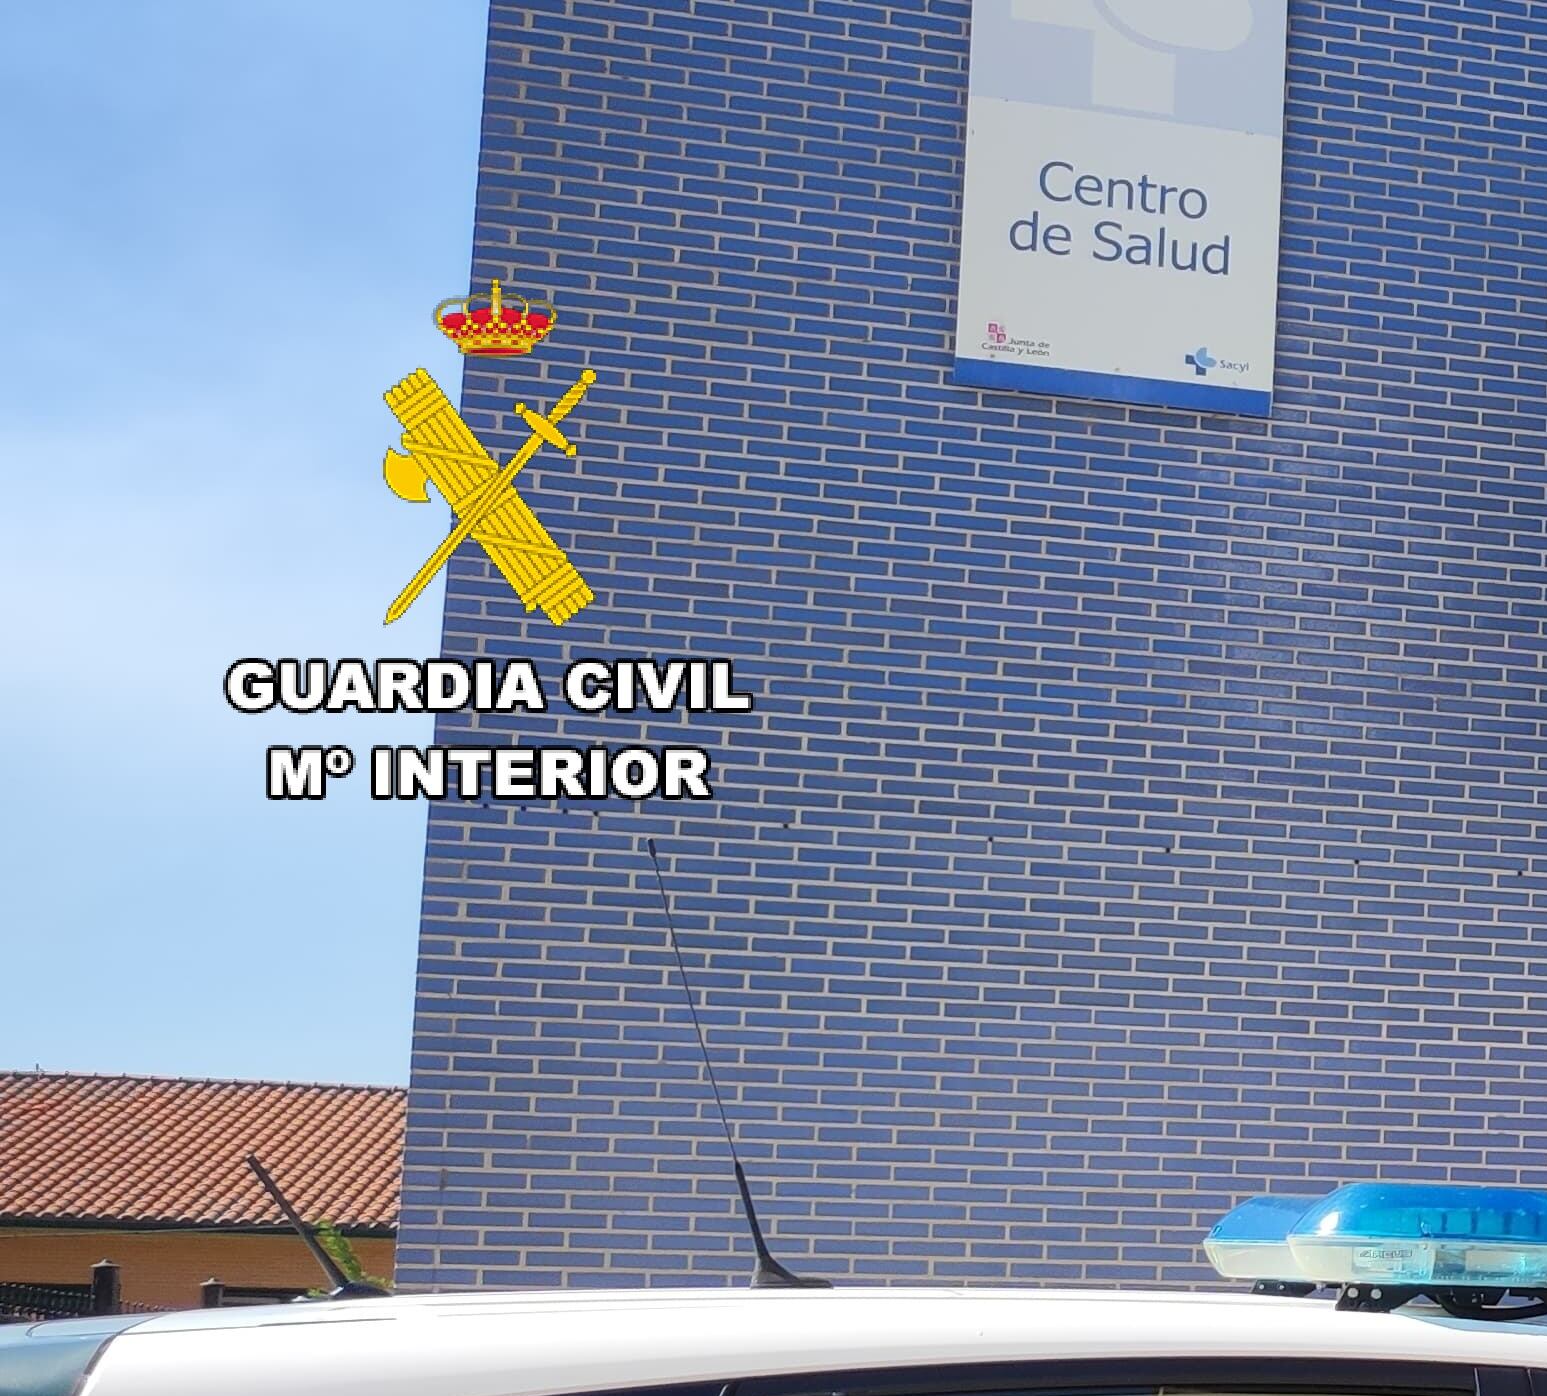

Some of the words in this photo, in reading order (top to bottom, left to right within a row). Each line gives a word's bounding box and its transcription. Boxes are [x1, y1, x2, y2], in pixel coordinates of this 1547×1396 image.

[1039, 161, 1208, 219] Centro
[1009, 210, 1072, 256] de
[1093, 221, 1230, 276] Salud
[981, 342, 1016, 353] Castilla
[1008, 338, 1036, 347] Junta
[1220, 359, 1250, 374] Sacyl
